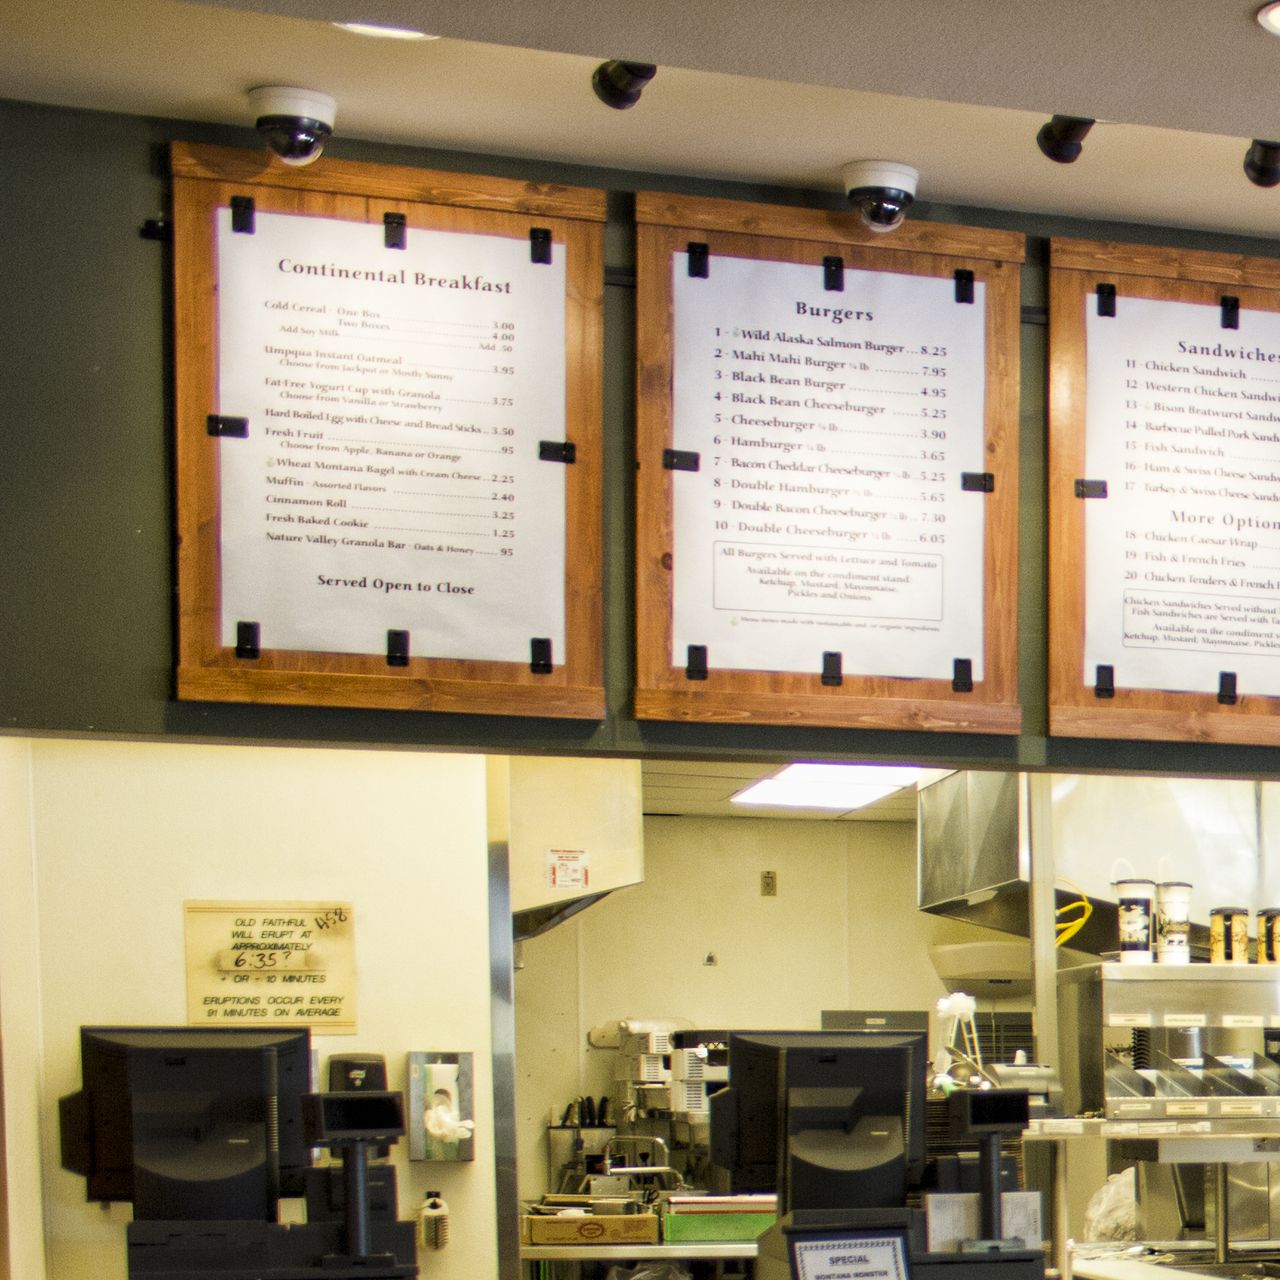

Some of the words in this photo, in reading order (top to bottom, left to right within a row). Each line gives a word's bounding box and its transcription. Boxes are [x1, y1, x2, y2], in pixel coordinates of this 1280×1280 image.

[278, 259, 406, 285] Continental
[415, 272, 511, 294] Breakfast
[796, 301, 874, 325] Burgers
[715, 327, 721, 337] 1
[741, 329, 771, 341] Wild
[775, 332, 814, 346] Alaska
[816, 337, 862, 350] Salmon
[864, 340, 905, 355] Burger
[920, 345, 948, 357] 8.25
[714, 348, 723, 359] 2
[733, 350, 766, 362] Mahi
[769, 353, 801, 365] Mahi
[804, 356, 846, 372] Burger
[922, 366, 947, 378] 7.95
[1126, 359, 1136, 369] 11
[1145, 360, 1190, 374] Chicken
[1192, 366, 1247, 380] Sandwich
[715, 370, 723, 380] 3
[732, 371, 766, 383] Black
[770, 374, 801, 386] Bean
[804, 377, 846, 393] Burger
[920, 387, 947, 398] 4.95
[1126, 379, 1138, 390] 12
[1145, 381, 1191, 394] Western
[1193, 385, 1238, 399] Chicken
[714, 392, 722, 402] 4
[731, 392, 766, 405] Black
[769, 396, 801, 408] Bean
[803, 398, 886, 417] Cheeseburger
[921, 407, 947, 419] 5.25
[1126, 400, 1138, 409] 13
[1154, 402, 1186, 414] Bison
[1188, 405, 1244, 420] Bratwurst
[265, 427, 294, 438] Fresh
[297, 429, 324, 440] Fruit
[276, 458, 312, 469] Wheat
[314, 461, 364, 473] Montana
[366, 465, 396, 477] Bagel
[397, 468, 419, 477] with
[419, 470, 450, 479] Cream
[451, 472, 481, 481] Cheese
[491, 474, 515, 484] 2.25
[265, 495, 323, 507] Cinnamon
[326, 499, 347, 508] Roll
[492, 511, 515, 520] 3.25
[1171, 510, 1215, 525] More
[266, 513, 295, 523] Fresh
[297, 515, 331, 526] Baked
[333, 518, 369, 529] Cookie
[493, 529, 516, 539] 1.25
[266, 532, 304, 543] Nature
[305, 535, 338, 547] Valley
[341, 537, 385, 548] Granola
[387, 540, 407, 550] Bar
[413, 543, 435, 552] Oats
[446, 545, 475, 556] Honey
[317, 575, 368, 589] Served
[372, 578, 413, 594] Open
[417, 582, 432, 592] to
[436, 582, 475, 595] Close
[235, 918, 256, 927] OLD
[262, 918, 307, 927] FAITHFUL
[231, 930, 253, 939] WILL
[261, 930, 293, 939] ERUPT
[300, 930, 312, 939] AT
[231, 942, 313, 951] APPROXIMATELY
[234, 975, 249, 983] OR
[266, 975, 277, 983] 10
[282, 975, 326, 983] MINUTES
[203, 996, 261, 1005] ERUPTIONS
[267, 996, 304, 1005] OCCUR
[309, 996, 344, 1005] EVERY
[207, 1008, 217, 1017] 91
[223, 1008, 268, 1017] MINUTES
[274, 1008, 290, 1017] ON
[295, 1008, 341, 1016] AVERAGE
[829, 1255, 870, 1265] SPECIAL
